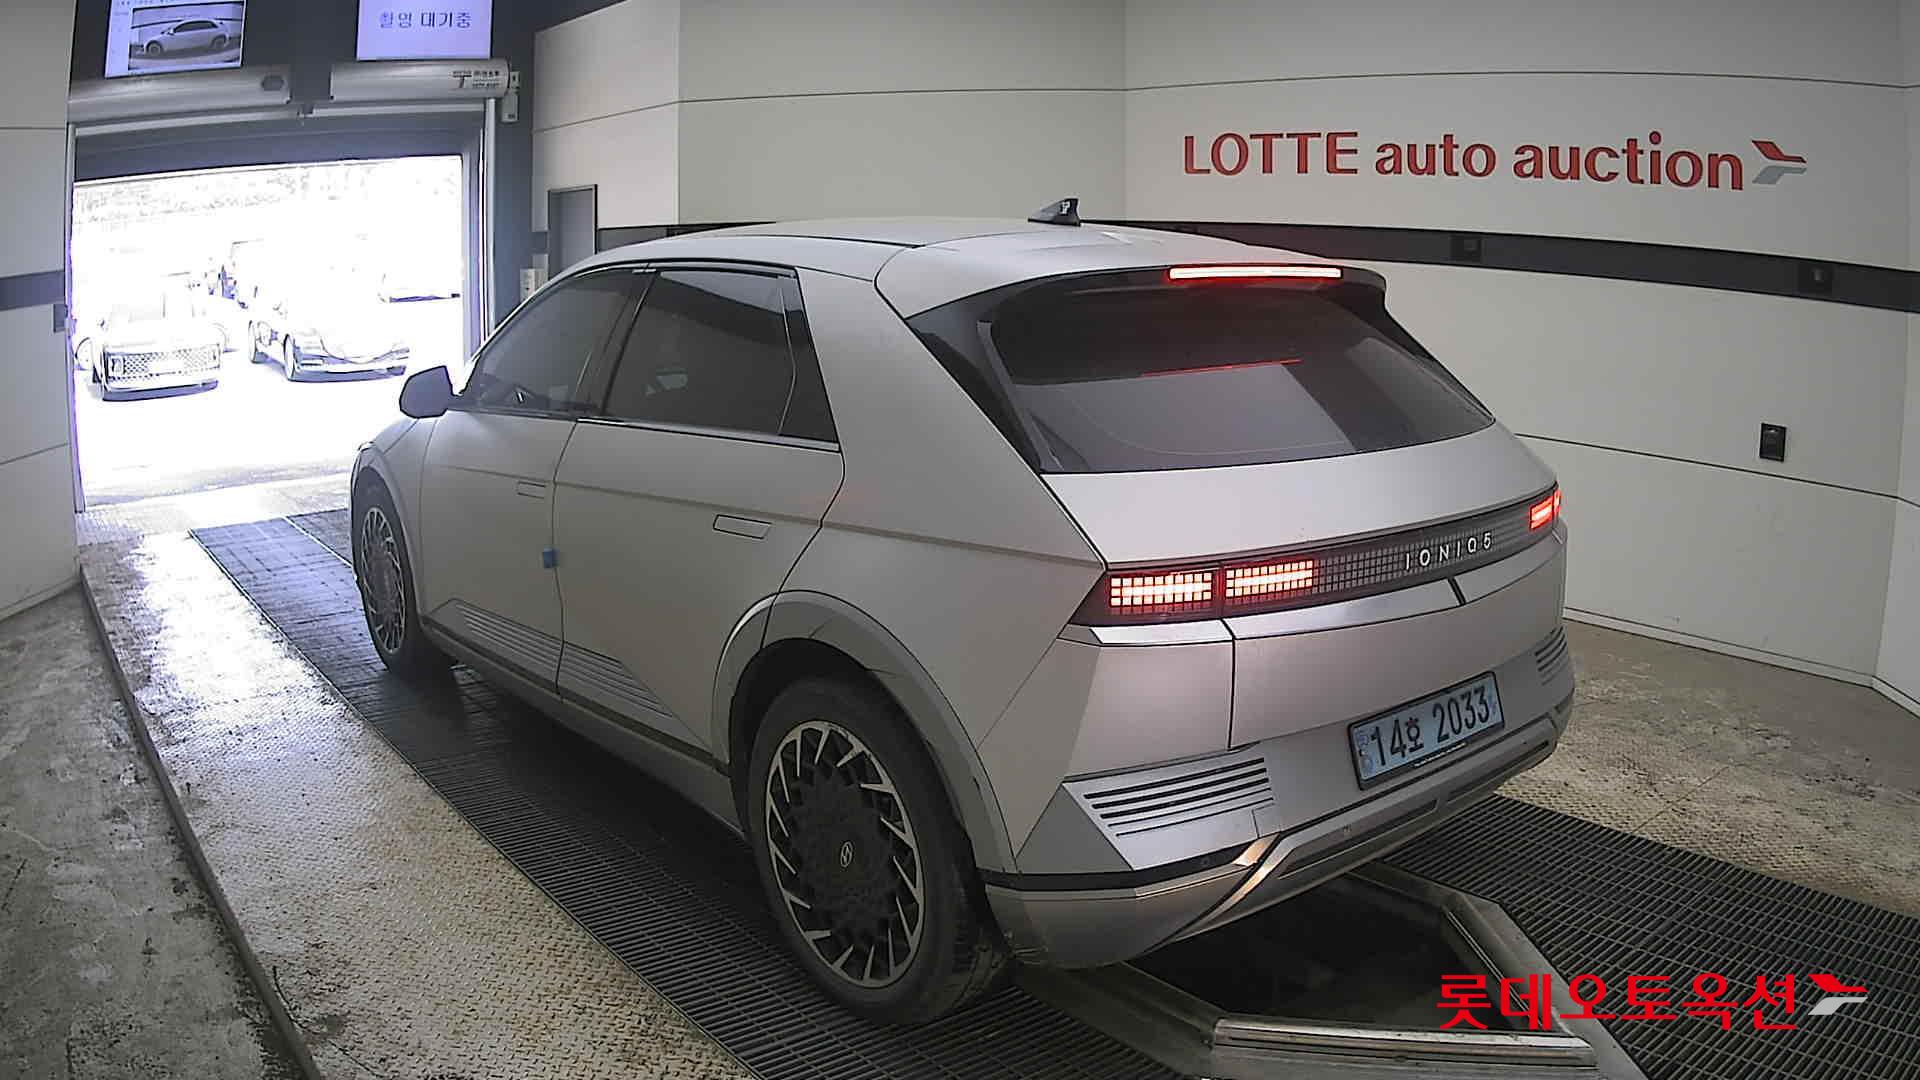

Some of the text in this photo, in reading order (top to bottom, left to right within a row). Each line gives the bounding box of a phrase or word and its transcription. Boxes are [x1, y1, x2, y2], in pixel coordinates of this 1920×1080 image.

[420, 12, 472, 28] 대기중
[1184, 131, 1743, 191] LOTTE auto auction
[1371, 687, 1490, 766] 14호 2033
